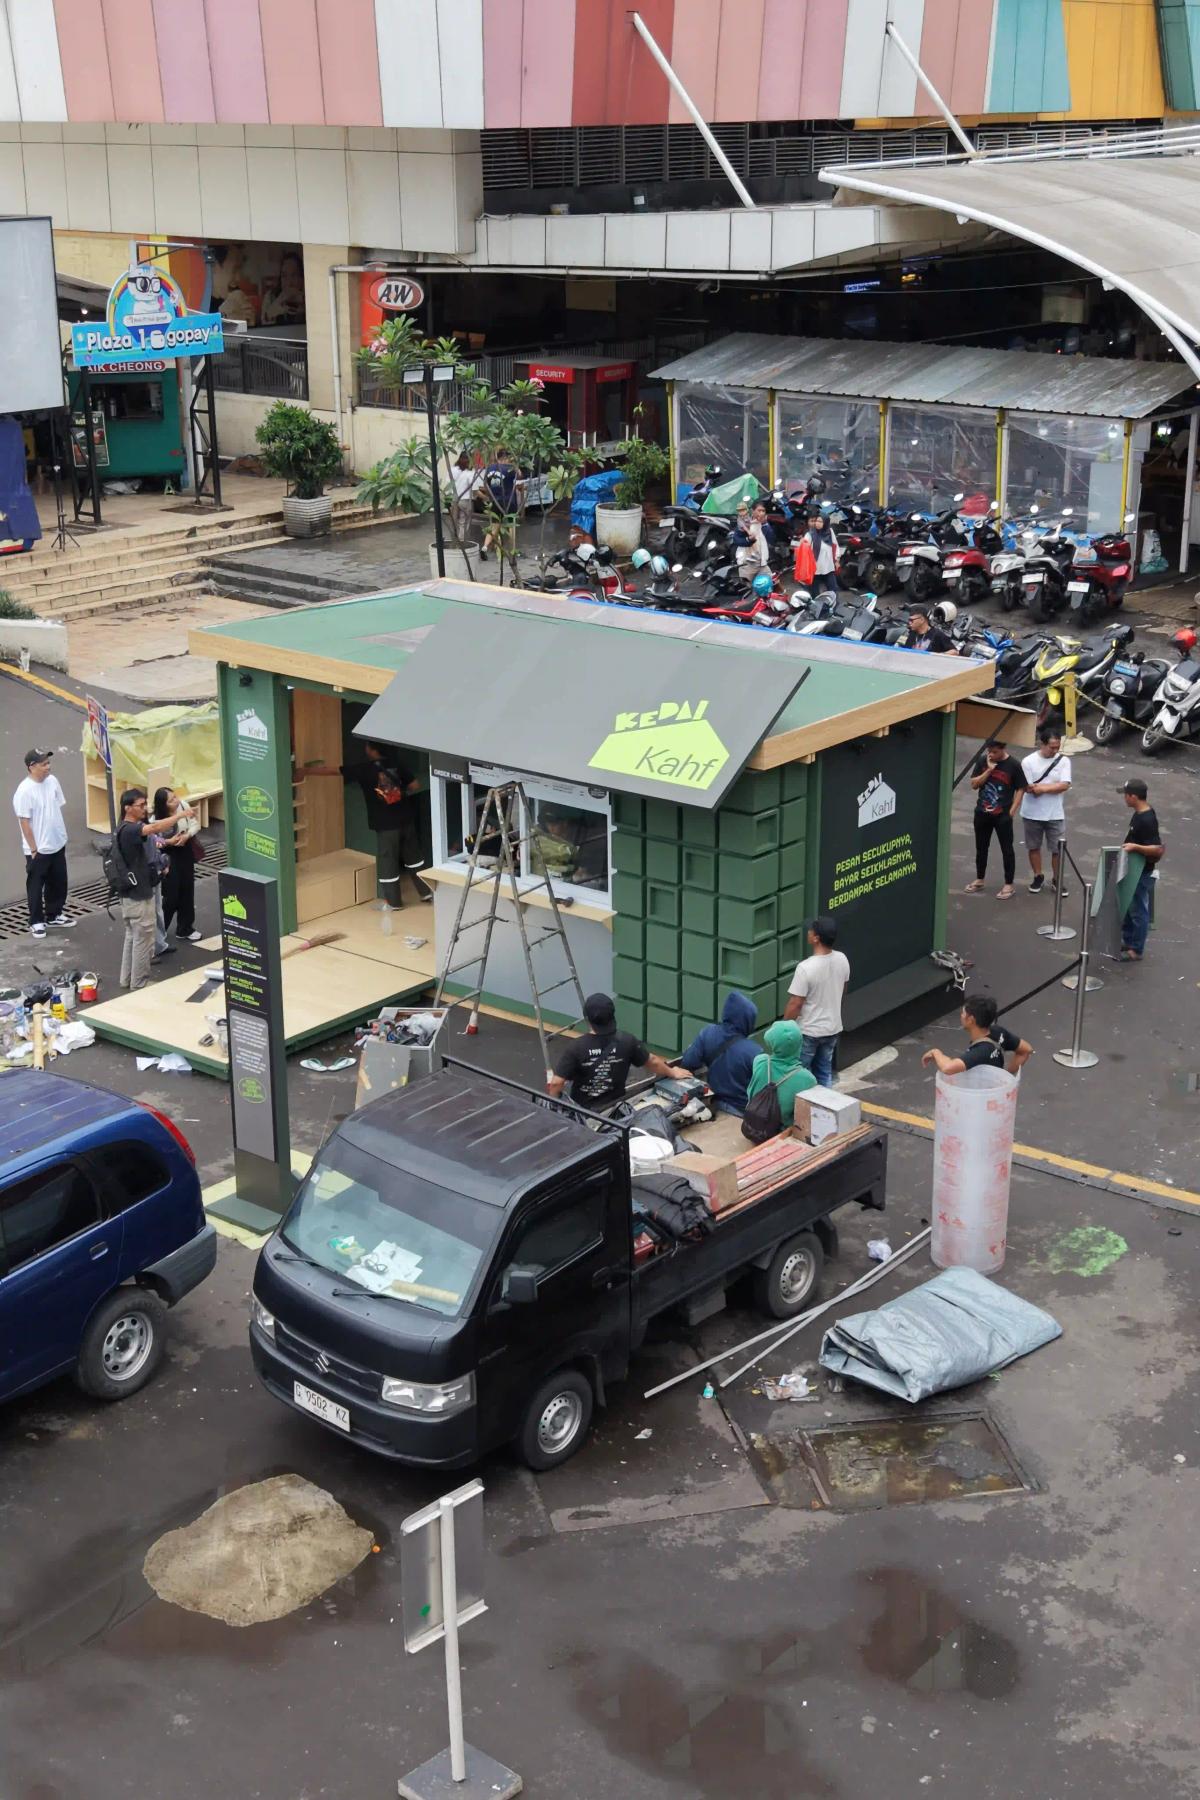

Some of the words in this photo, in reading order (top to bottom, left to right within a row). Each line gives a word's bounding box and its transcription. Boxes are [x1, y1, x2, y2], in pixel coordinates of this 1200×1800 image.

[87, 332, 133, 352] Plaza
[166, 326, 211, 348] gopay
[110, 361, 162, 372] CHEONG
[535, 369, 566, 378] SECURITY
[615, 700, 709, 732] KEDAI
[635, 746, 719, 782] Kahf
[871, 797, 894, 819] Kahf
[836, 854, 861, 874] PESAN
[862, 833, 913, 862] SECUKUPNYA,
[828, 881, 874, 910] BERDAMPAK
[875, 862, 917, 889] SELAMANYA
[834, 871, 860, 891] BAYAR
[860, 850, 913, 879] SEIKHLASNYA,
[306, 1390, 328, 1413] 9502
[335, 1406, 347, 1424] KZ
